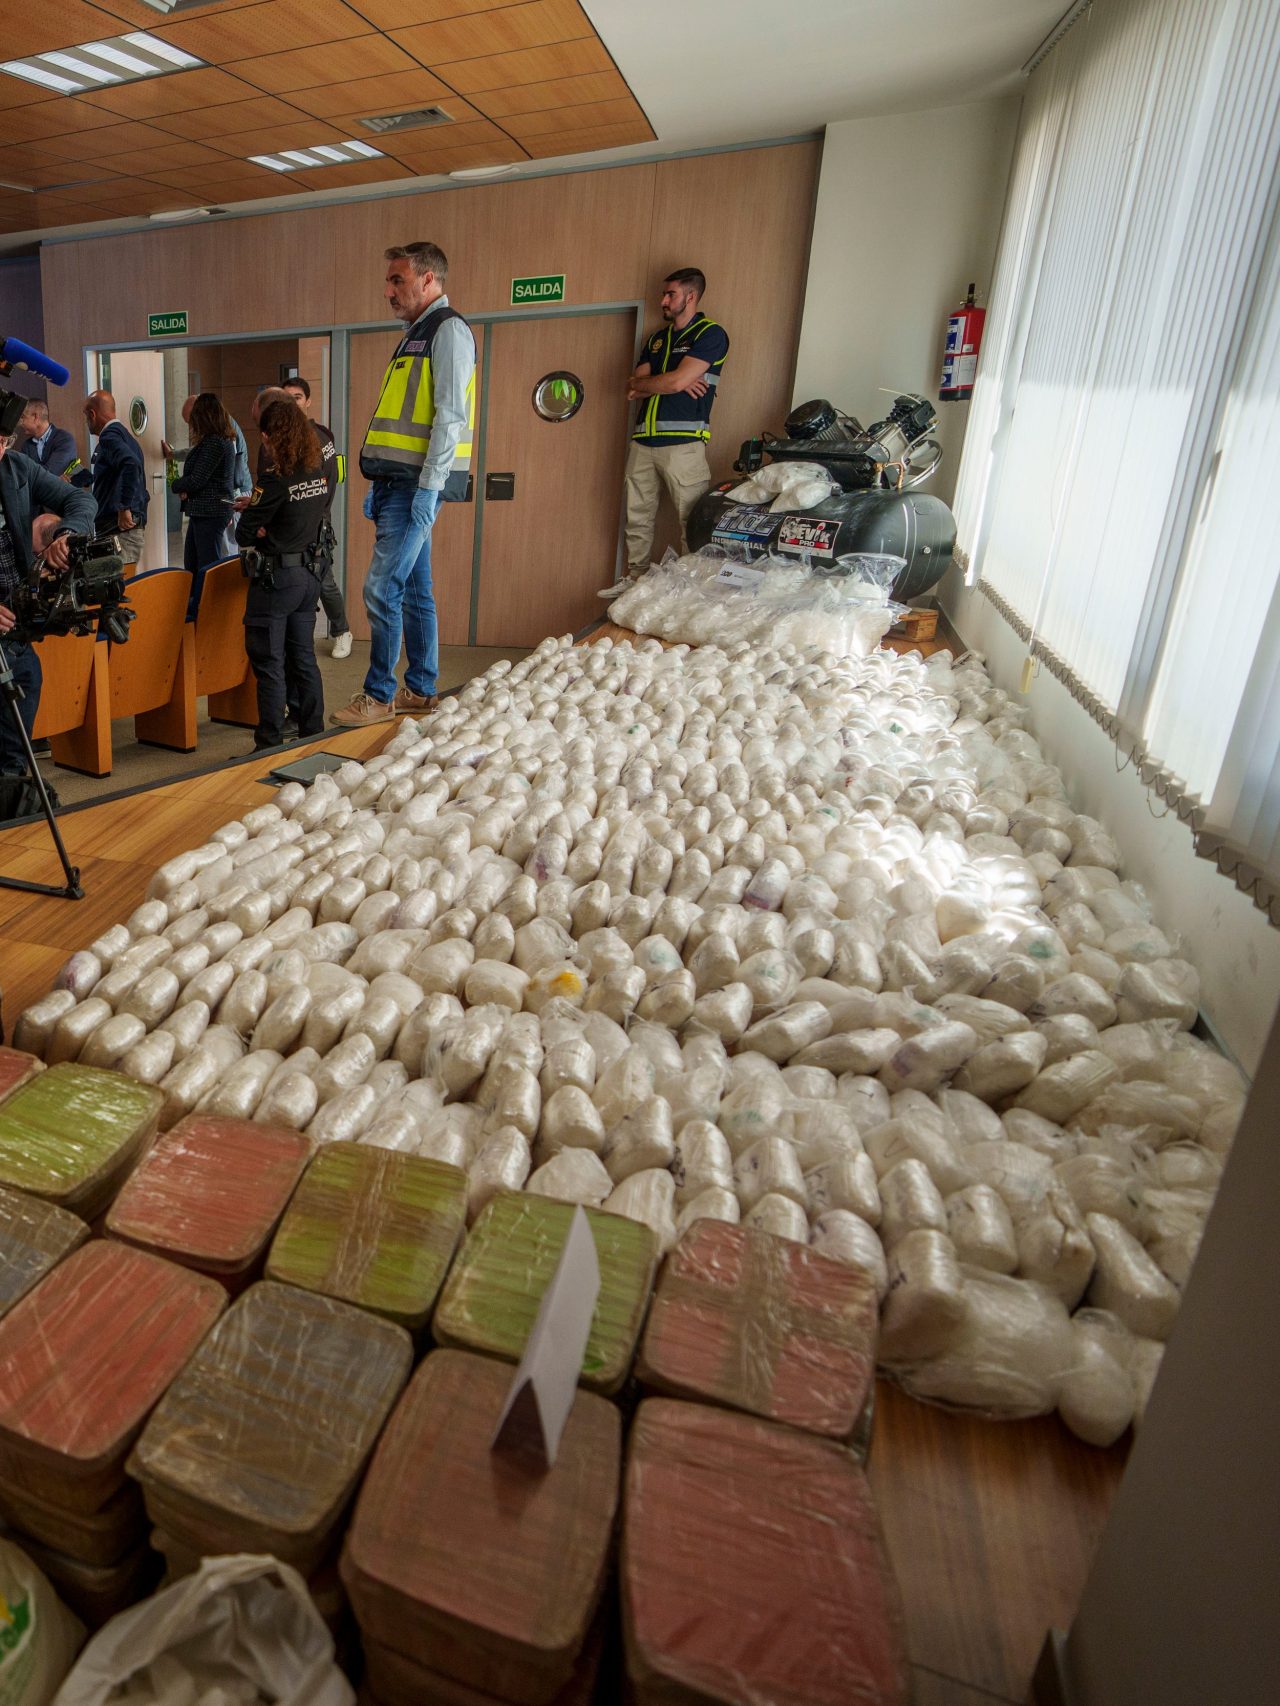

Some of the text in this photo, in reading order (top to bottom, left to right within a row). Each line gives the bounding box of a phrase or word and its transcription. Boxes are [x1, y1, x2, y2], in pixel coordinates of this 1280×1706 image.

[515, 282, 562, 297] SALIDA
[151, 318, 186, 331] SALIDA
[799, 539, 815, 548] PRO
